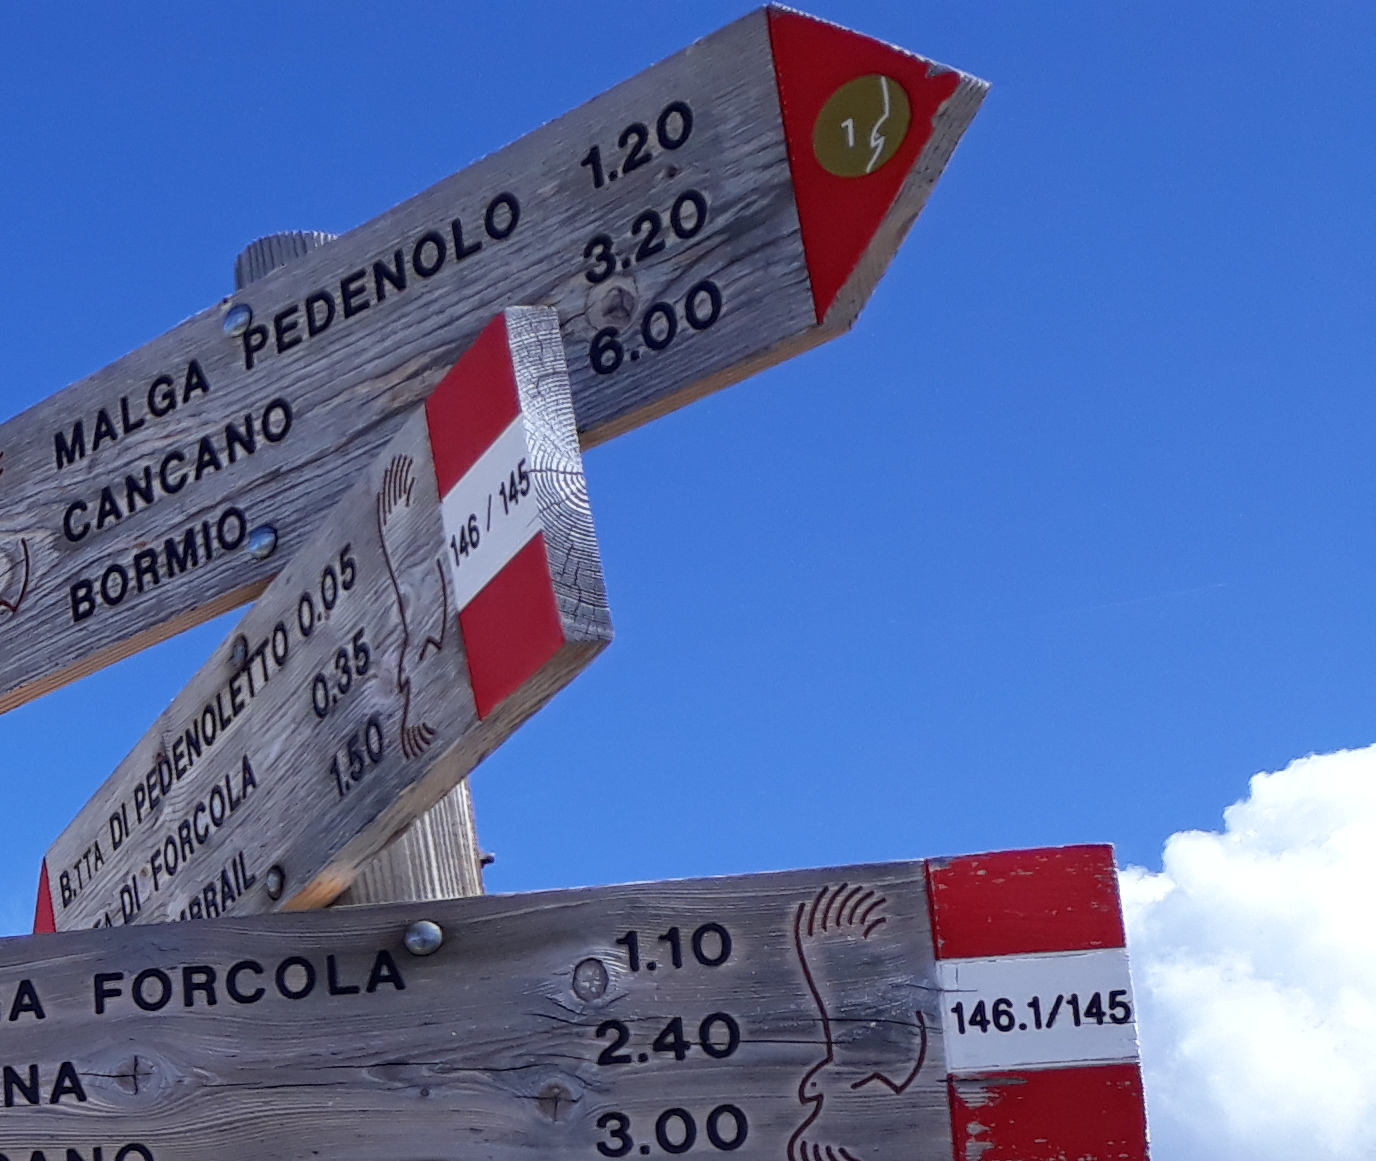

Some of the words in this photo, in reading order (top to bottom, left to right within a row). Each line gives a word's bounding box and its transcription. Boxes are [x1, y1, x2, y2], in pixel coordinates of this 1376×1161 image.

[580, 100, 694, 188] 1.20
[583, 189, 708, 283] 3.20
[54, 359, 210, 470] MALGA
[242, 191, 521, 370] PEDENOLO
[589, 280, 723, 375] 6.00
[63, 398, 294, 543] CANCANO
[450, 513, 481, 567] 146
[499, 457, 531, 516] 145
[70, 506, 248, 623] BORMIO
[59, 840, 106, 909] B.TTA
[109, 803, 130, 851] DI
[133, 621, 289, 824] PEDENOLETTO
[298, 543, 357, 637] 0.05
[330, 711, 384, 797] 1.50
[119, 874, 142, 924] DI
[150, 753, 257, 892] FORCOLA
[312, 627, 371, 719] 0.35
[93, 949, 407, 1015] FORCOLA
[616, 922, 733, 973] 1.10
[951, 989, 1132, 1035] 146.1/145
[594, 1011, 741, 1066] 2.40
[595, 1104, 749, 1158] 3.00
